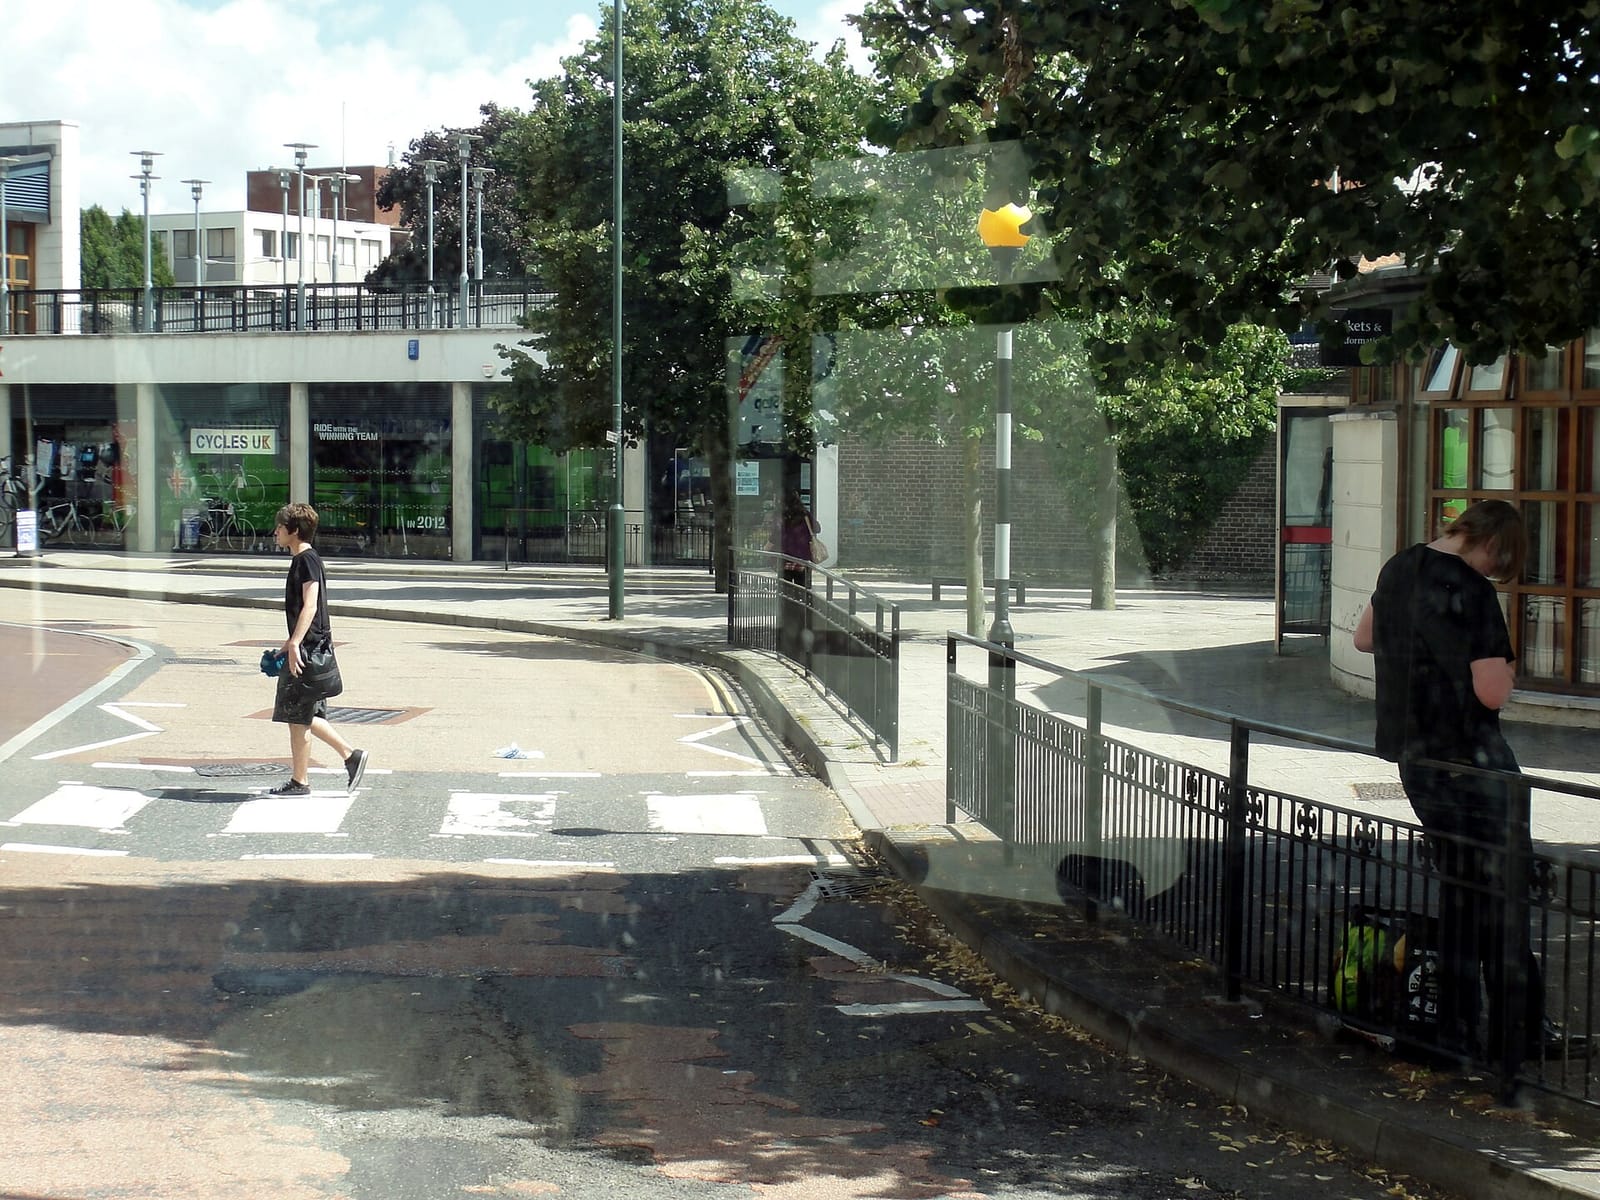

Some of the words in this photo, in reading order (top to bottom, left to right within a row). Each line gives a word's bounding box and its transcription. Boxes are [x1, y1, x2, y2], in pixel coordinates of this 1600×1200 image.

[1347, 319, 1371, 332] kets
[1374, 322, 1382, 332] &
[313, 423, 333, 432] RIDE
[196, 434, 249, 449] CYCLES
[252, 435, 271, 449] UK
[319, 432, 354, 441] WINNING
[356, 432, 378, 441] TEAM
[407, 520, 416, 528] IN
[417, 515, 446, 529] 2012
